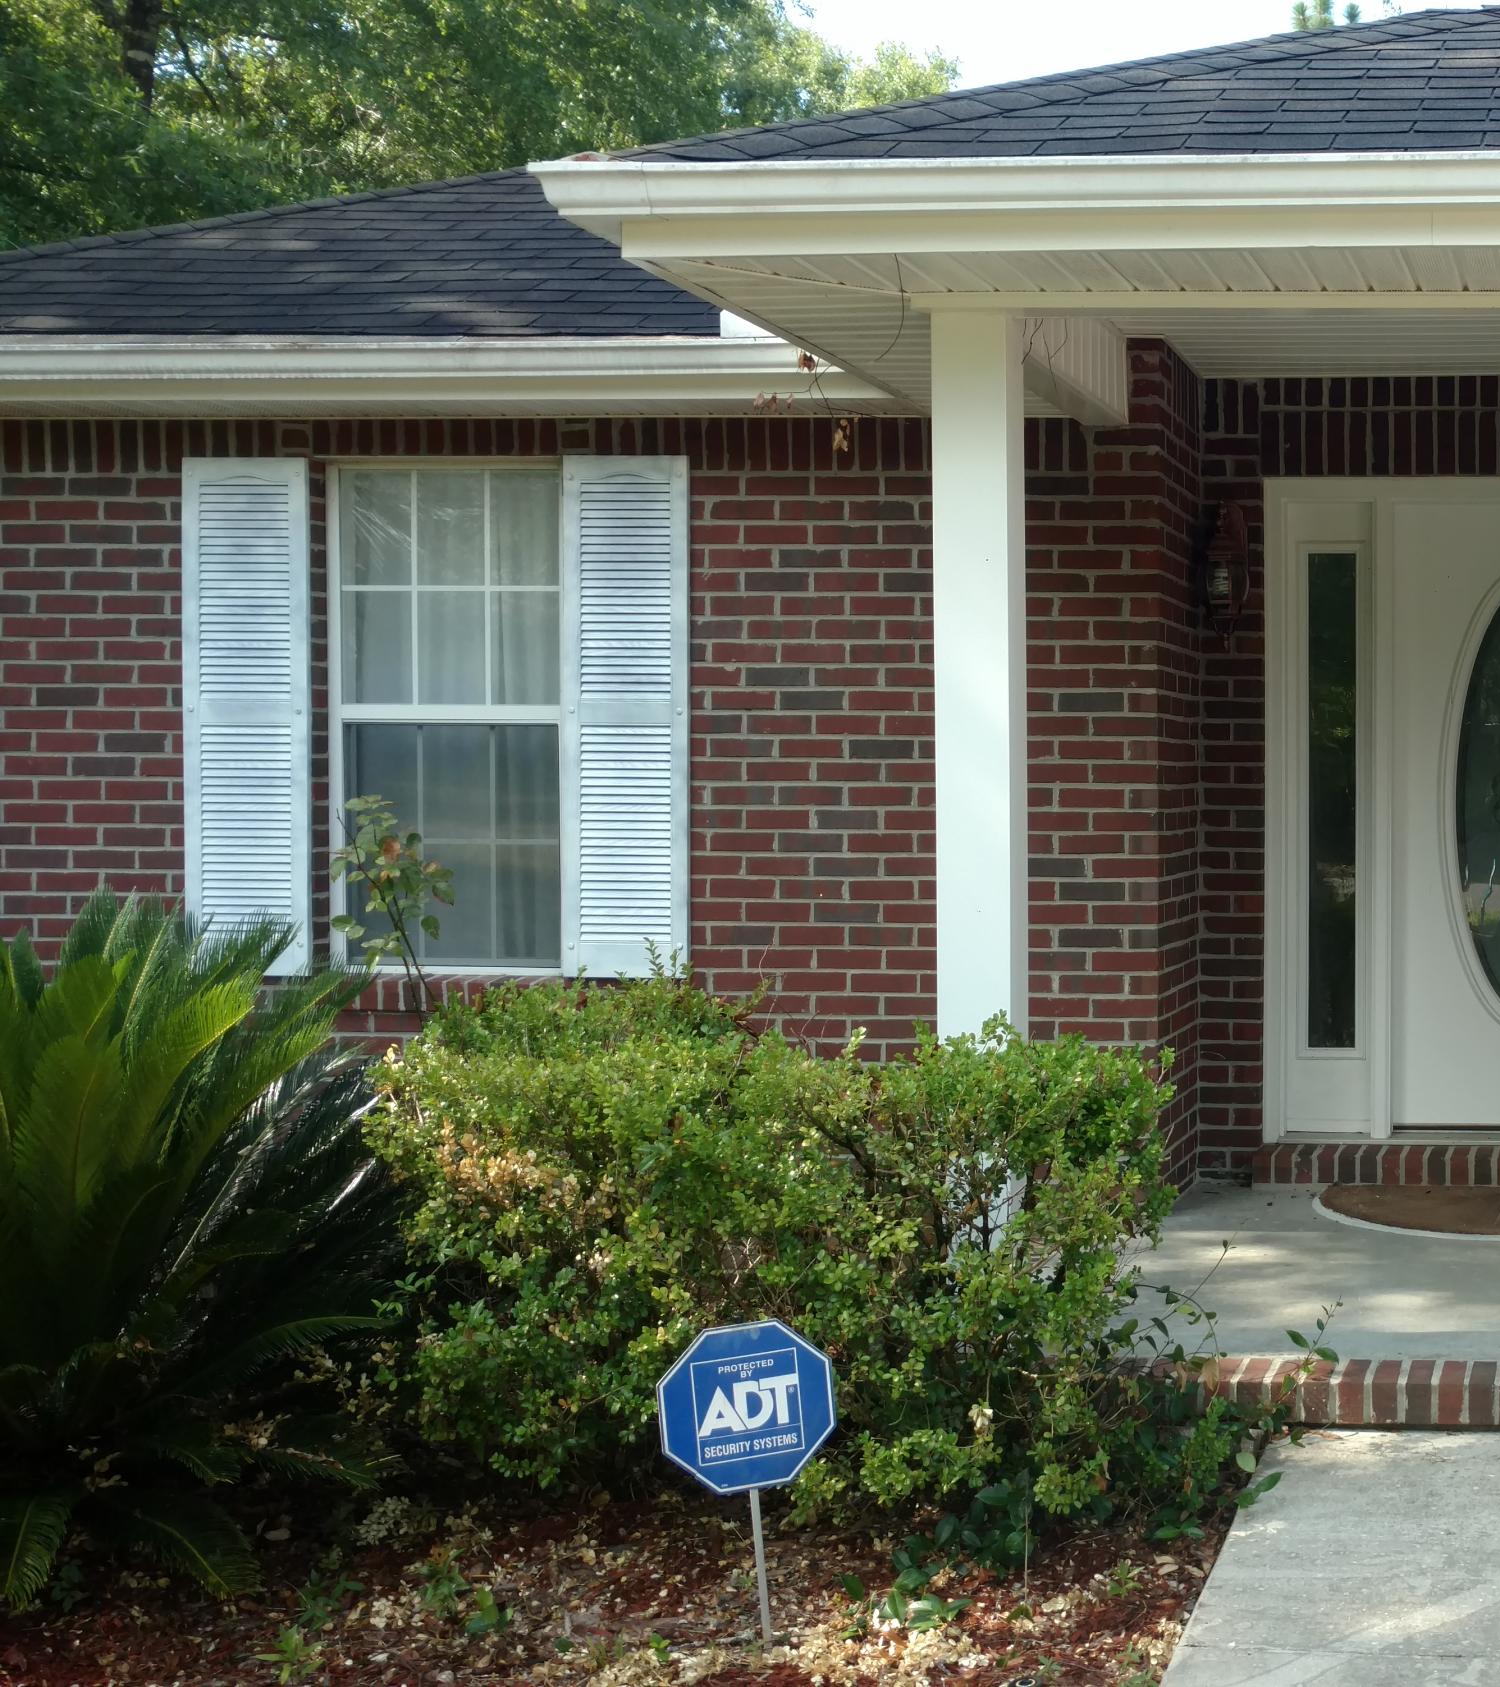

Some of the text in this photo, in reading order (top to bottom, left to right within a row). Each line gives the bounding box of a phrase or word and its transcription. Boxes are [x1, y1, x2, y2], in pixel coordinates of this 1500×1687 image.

[718, 1359, 774, 1374] PROTECTED
[740, 1370, 753, 1378] BY
[698, 1373, 798, 1437] ADT
[704, 1433, 798, 1459] SECURITY SYSTEMS
